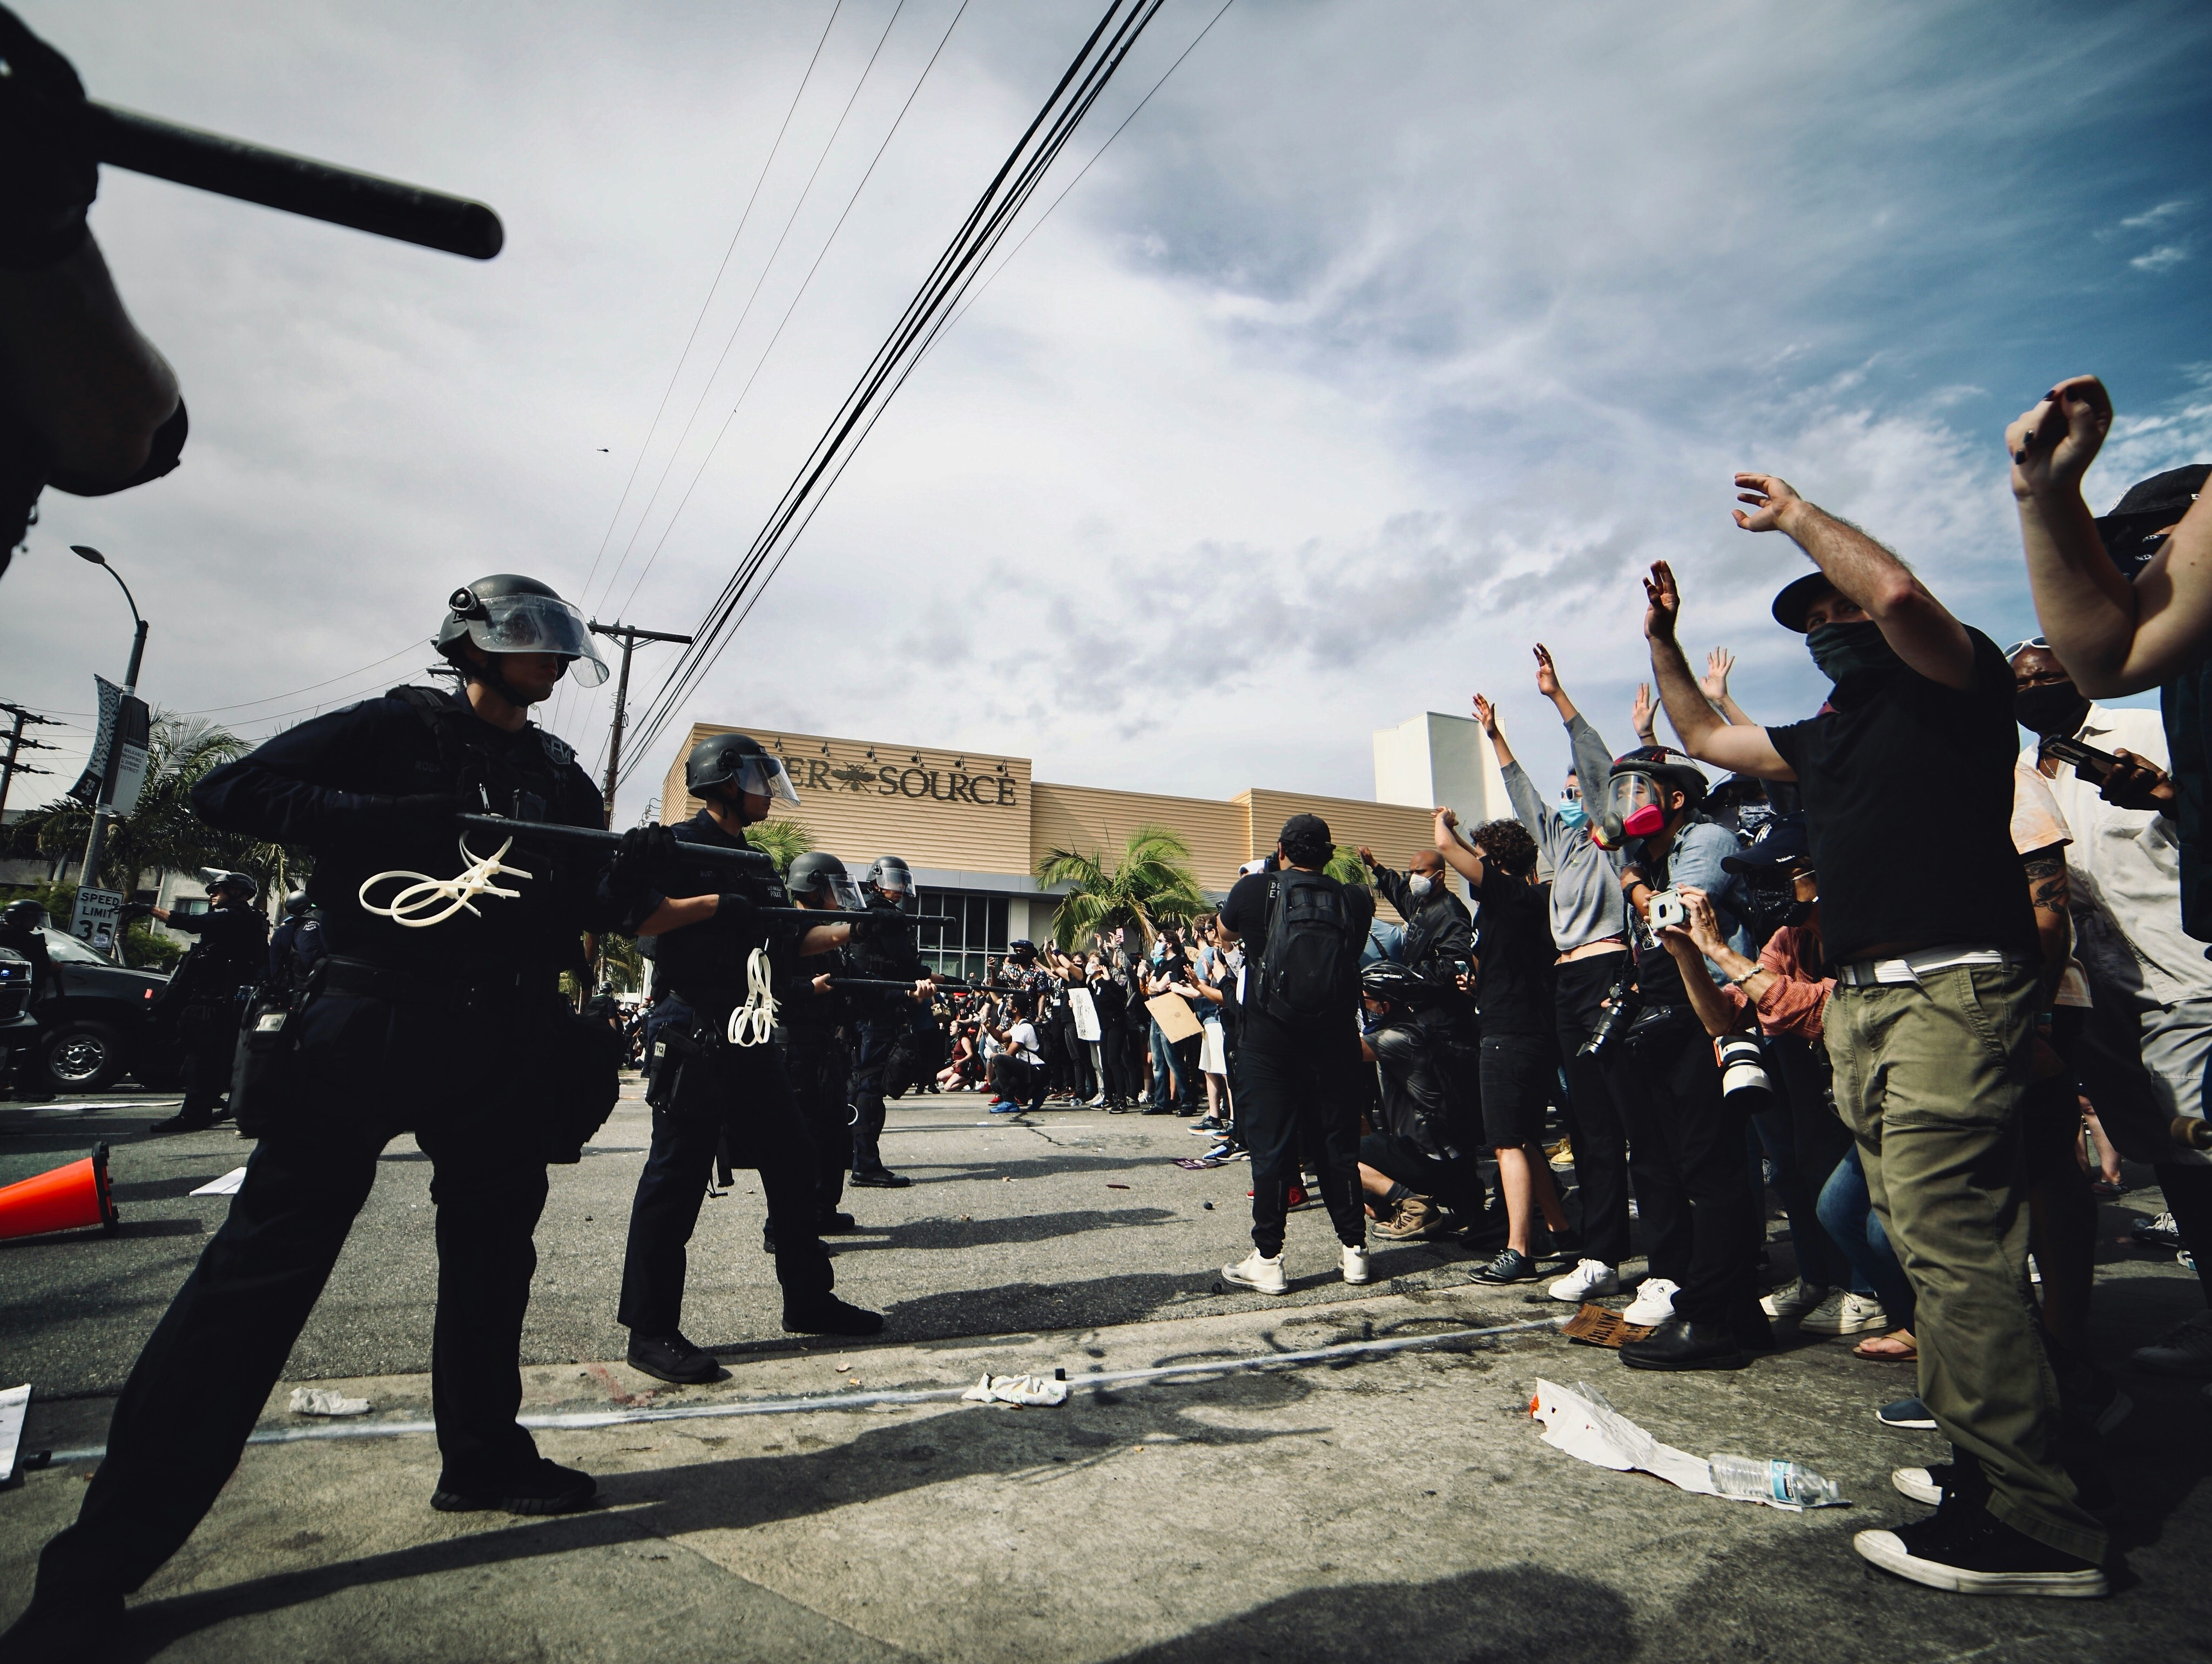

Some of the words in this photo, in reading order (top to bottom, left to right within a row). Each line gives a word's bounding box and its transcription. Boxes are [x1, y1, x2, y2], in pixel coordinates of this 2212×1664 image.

[124, 748, 145, 759] WALKABLE
[119, 764, 139, 774] DISTRICT
[125, 760, 140, 768] DINING
[878, 766, 1016, 806] SOURCE
[80, 892, 119, 906] SPEED
[82, 906, 113, 918] LIMIT
[75, 919, 112, 941] 35
[656, 1045, 664, 1053] TQ
